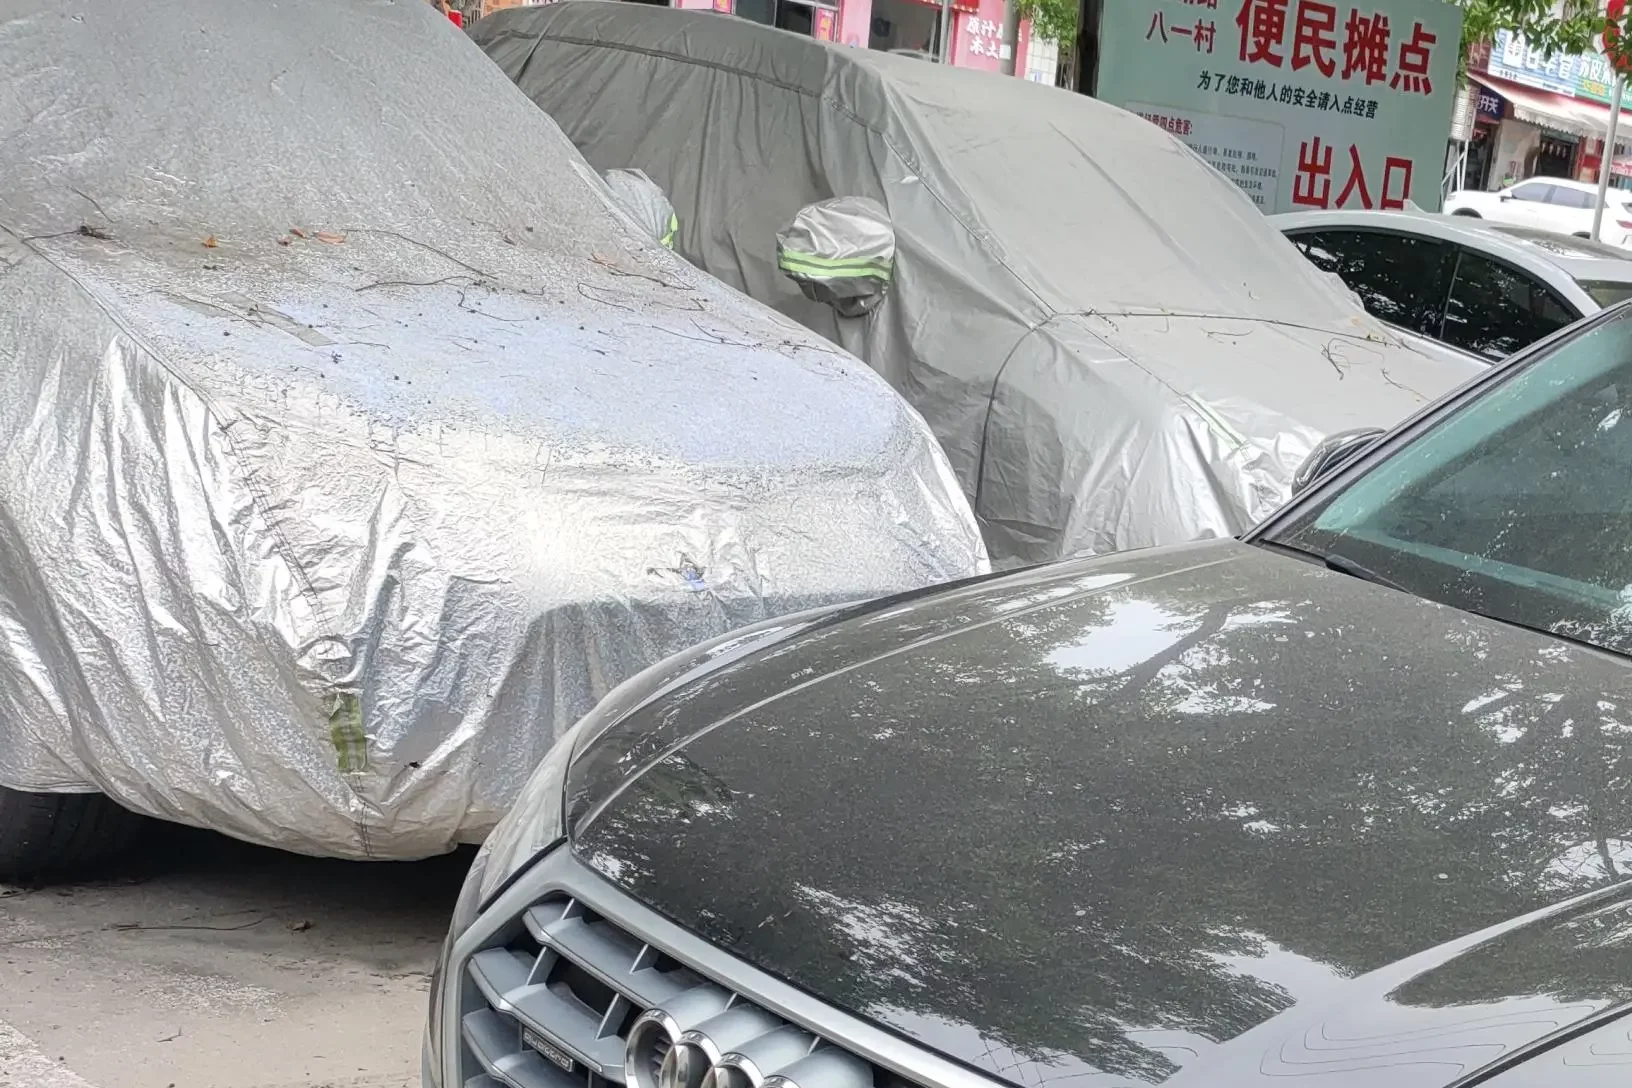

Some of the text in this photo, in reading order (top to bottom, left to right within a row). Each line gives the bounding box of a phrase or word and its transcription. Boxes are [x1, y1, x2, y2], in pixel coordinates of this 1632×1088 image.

[1146, 11, 1216, 53] 八一村
[1236, 0, 1436, 95] 便民摊点
[1197, 70, 1379, 119] 为了您和他人的安全请入点经营
[1292, 136, 1413, 210] 出入口
